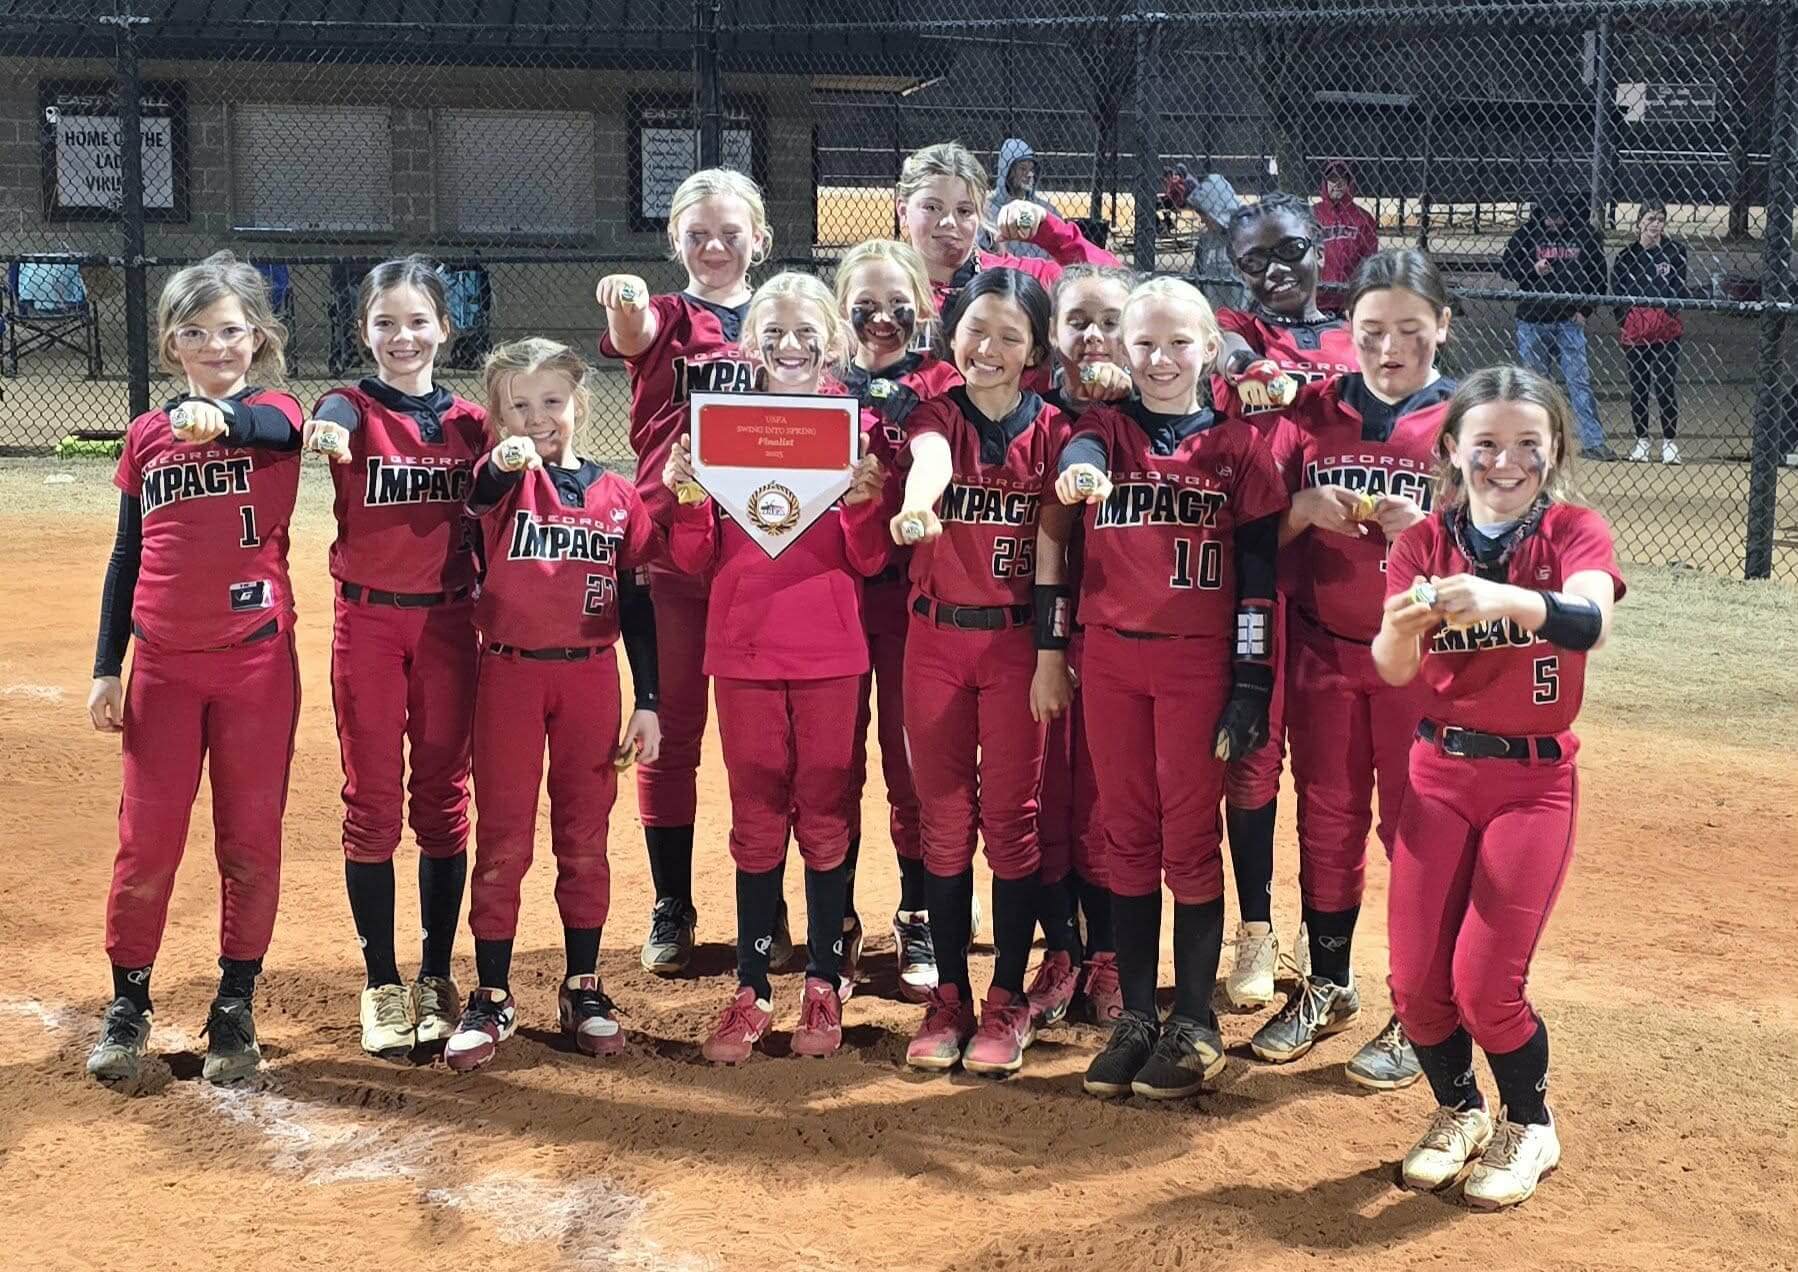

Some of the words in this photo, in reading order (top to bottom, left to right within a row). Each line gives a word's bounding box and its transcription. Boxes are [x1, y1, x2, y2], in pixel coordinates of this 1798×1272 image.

[65, 131, 109, 147] HOME
[95, 153, 122, 170] LAD
[736, 425, 764, 434] SWING
[765, 427, 785, 435] INTO
[786, 427, 817, 437] SPRING
[758, 436, 795, 447] Finalist
[364, 456, 470, 507] IMPAC
[1323, 454, 1425, 470] GEORGI
[938, 481, 1041, 526] MPACT
[240, 505, 260, 548] 1
[992, 536, 1036, 578] 25
[1169, 538, 1223, 590] 10
[1533, 655, 1559, 705] 5
